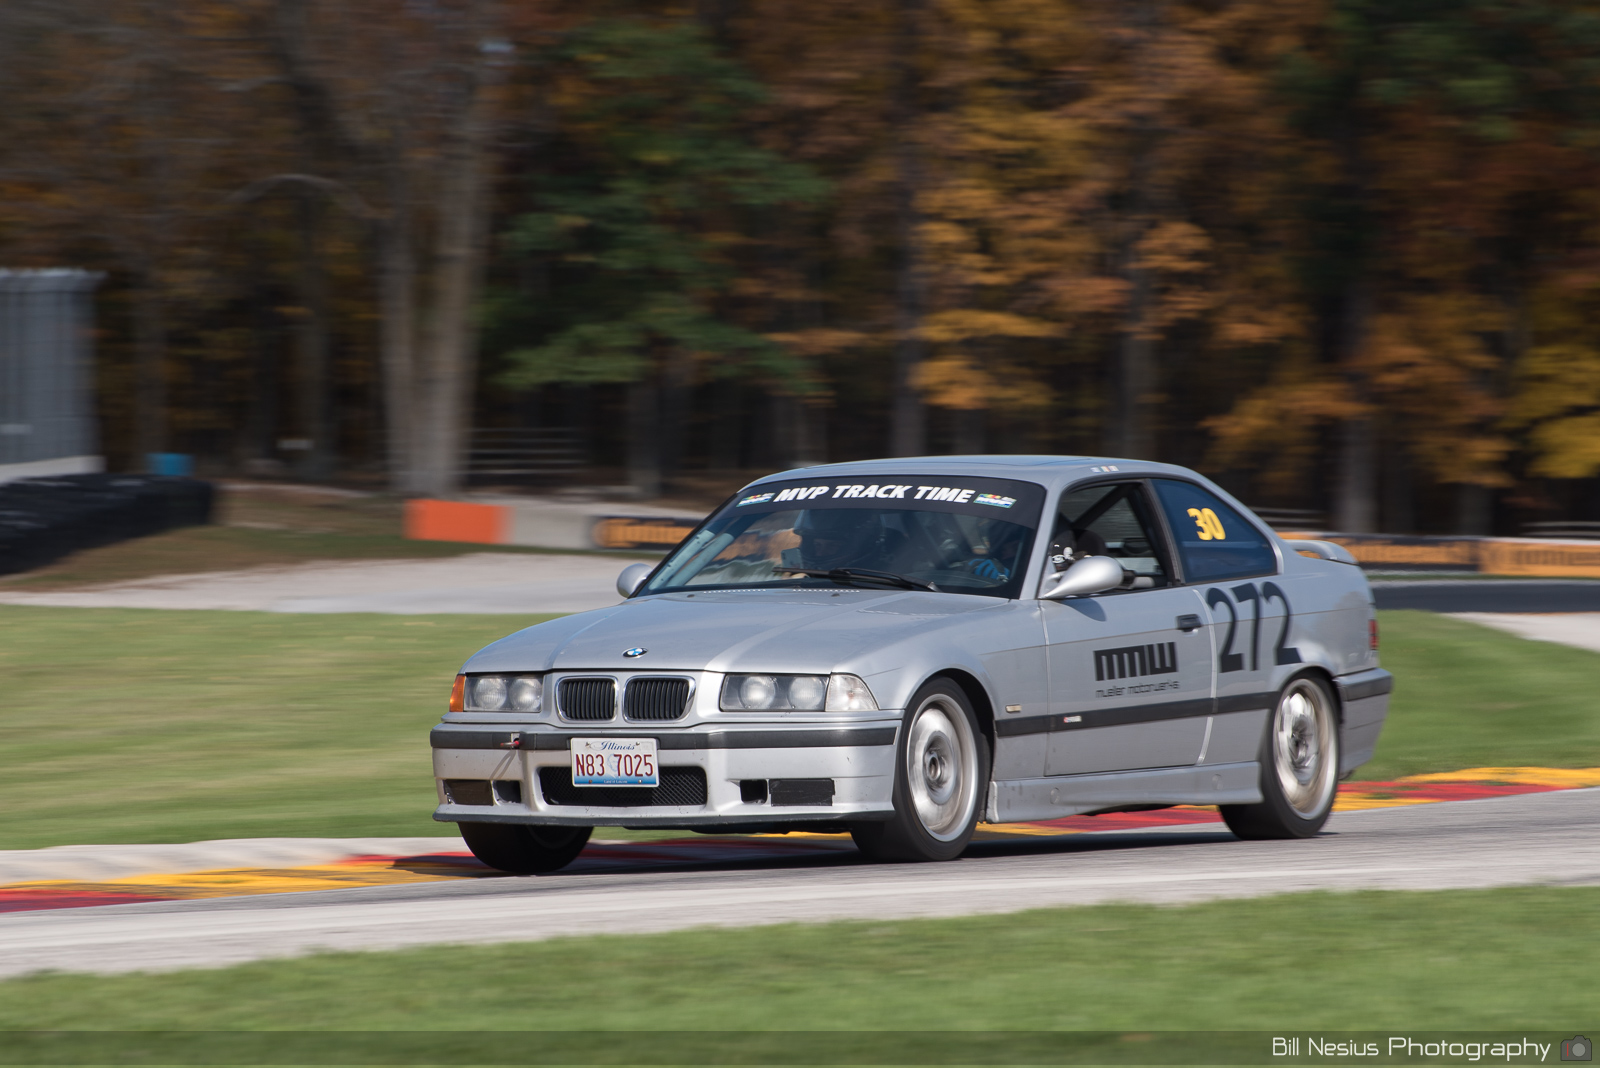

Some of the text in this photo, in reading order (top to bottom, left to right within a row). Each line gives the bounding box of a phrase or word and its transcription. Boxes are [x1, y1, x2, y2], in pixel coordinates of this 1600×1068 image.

[773, 486, 827, 502] MVP
[832, 484, 913, 499] TRACK
[916, 485, 976, 504] TIME
[1187, 507, 1226, 540] 30
[1206, 581, 1303, 673] 272
[600, 741, 636, 751] Illinois
[575, 753, 654, 777] N83 7025
